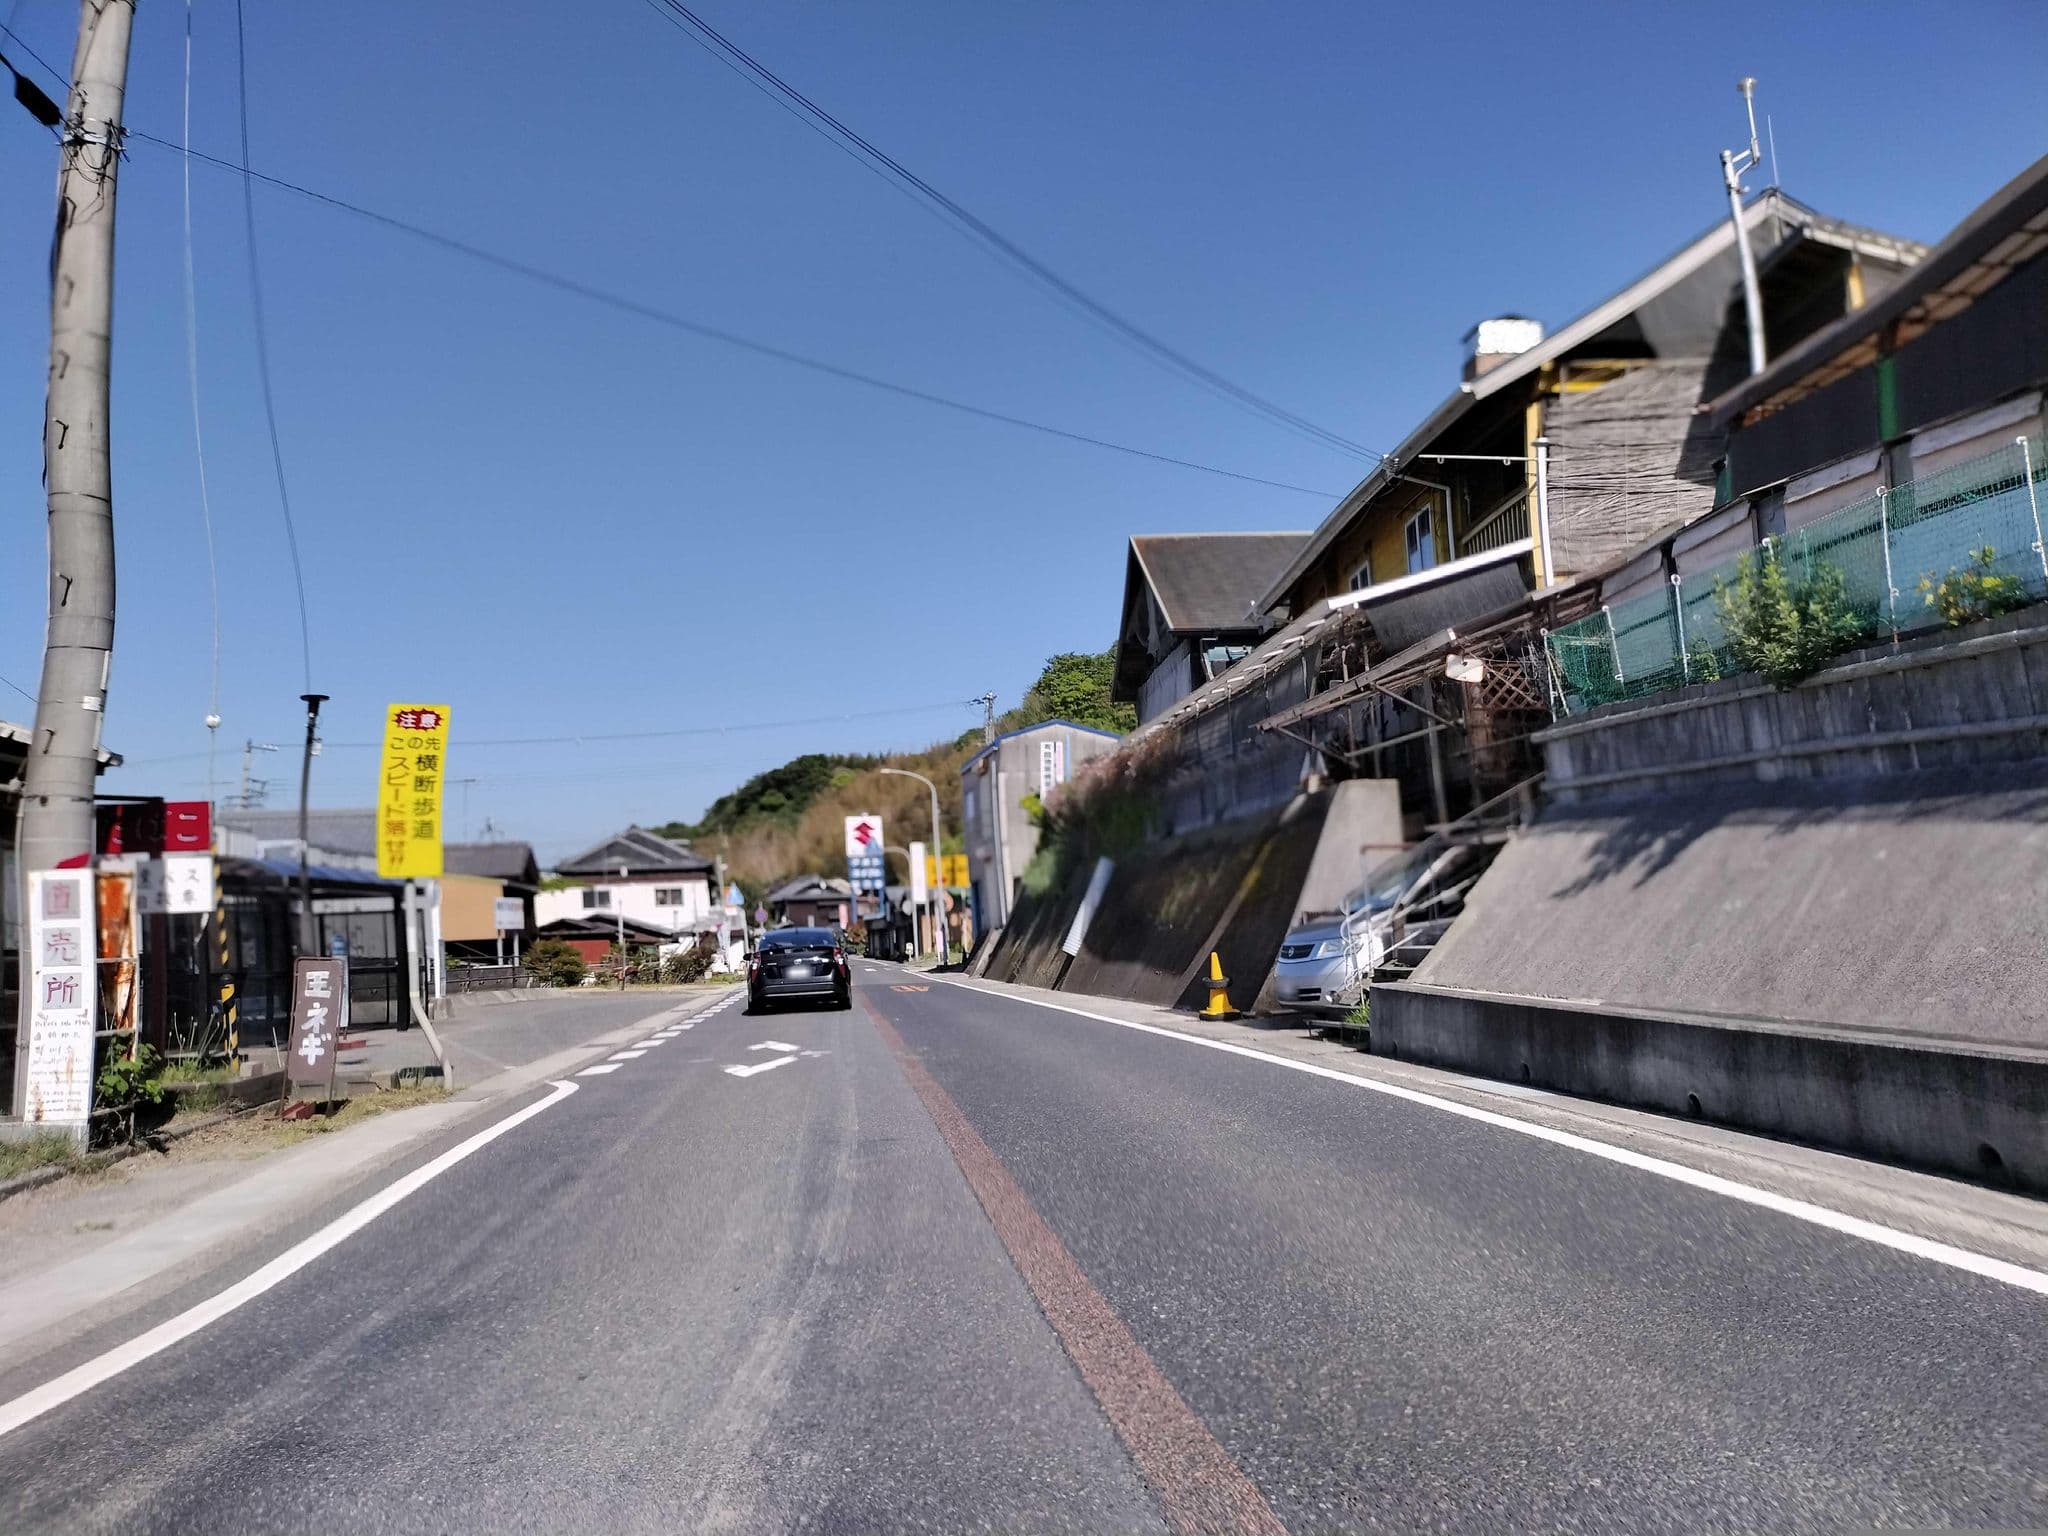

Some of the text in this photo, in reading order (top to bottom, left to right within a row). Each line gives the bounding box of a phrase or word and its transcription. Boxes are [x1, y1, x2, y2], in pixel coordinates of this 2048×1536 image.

[391, 737, 440, 750] この先
[400, 713, 438, 728] 注意
[413, 754, 438, 839] 横断歩道
[46, 881, 79, 1004] 直売所
